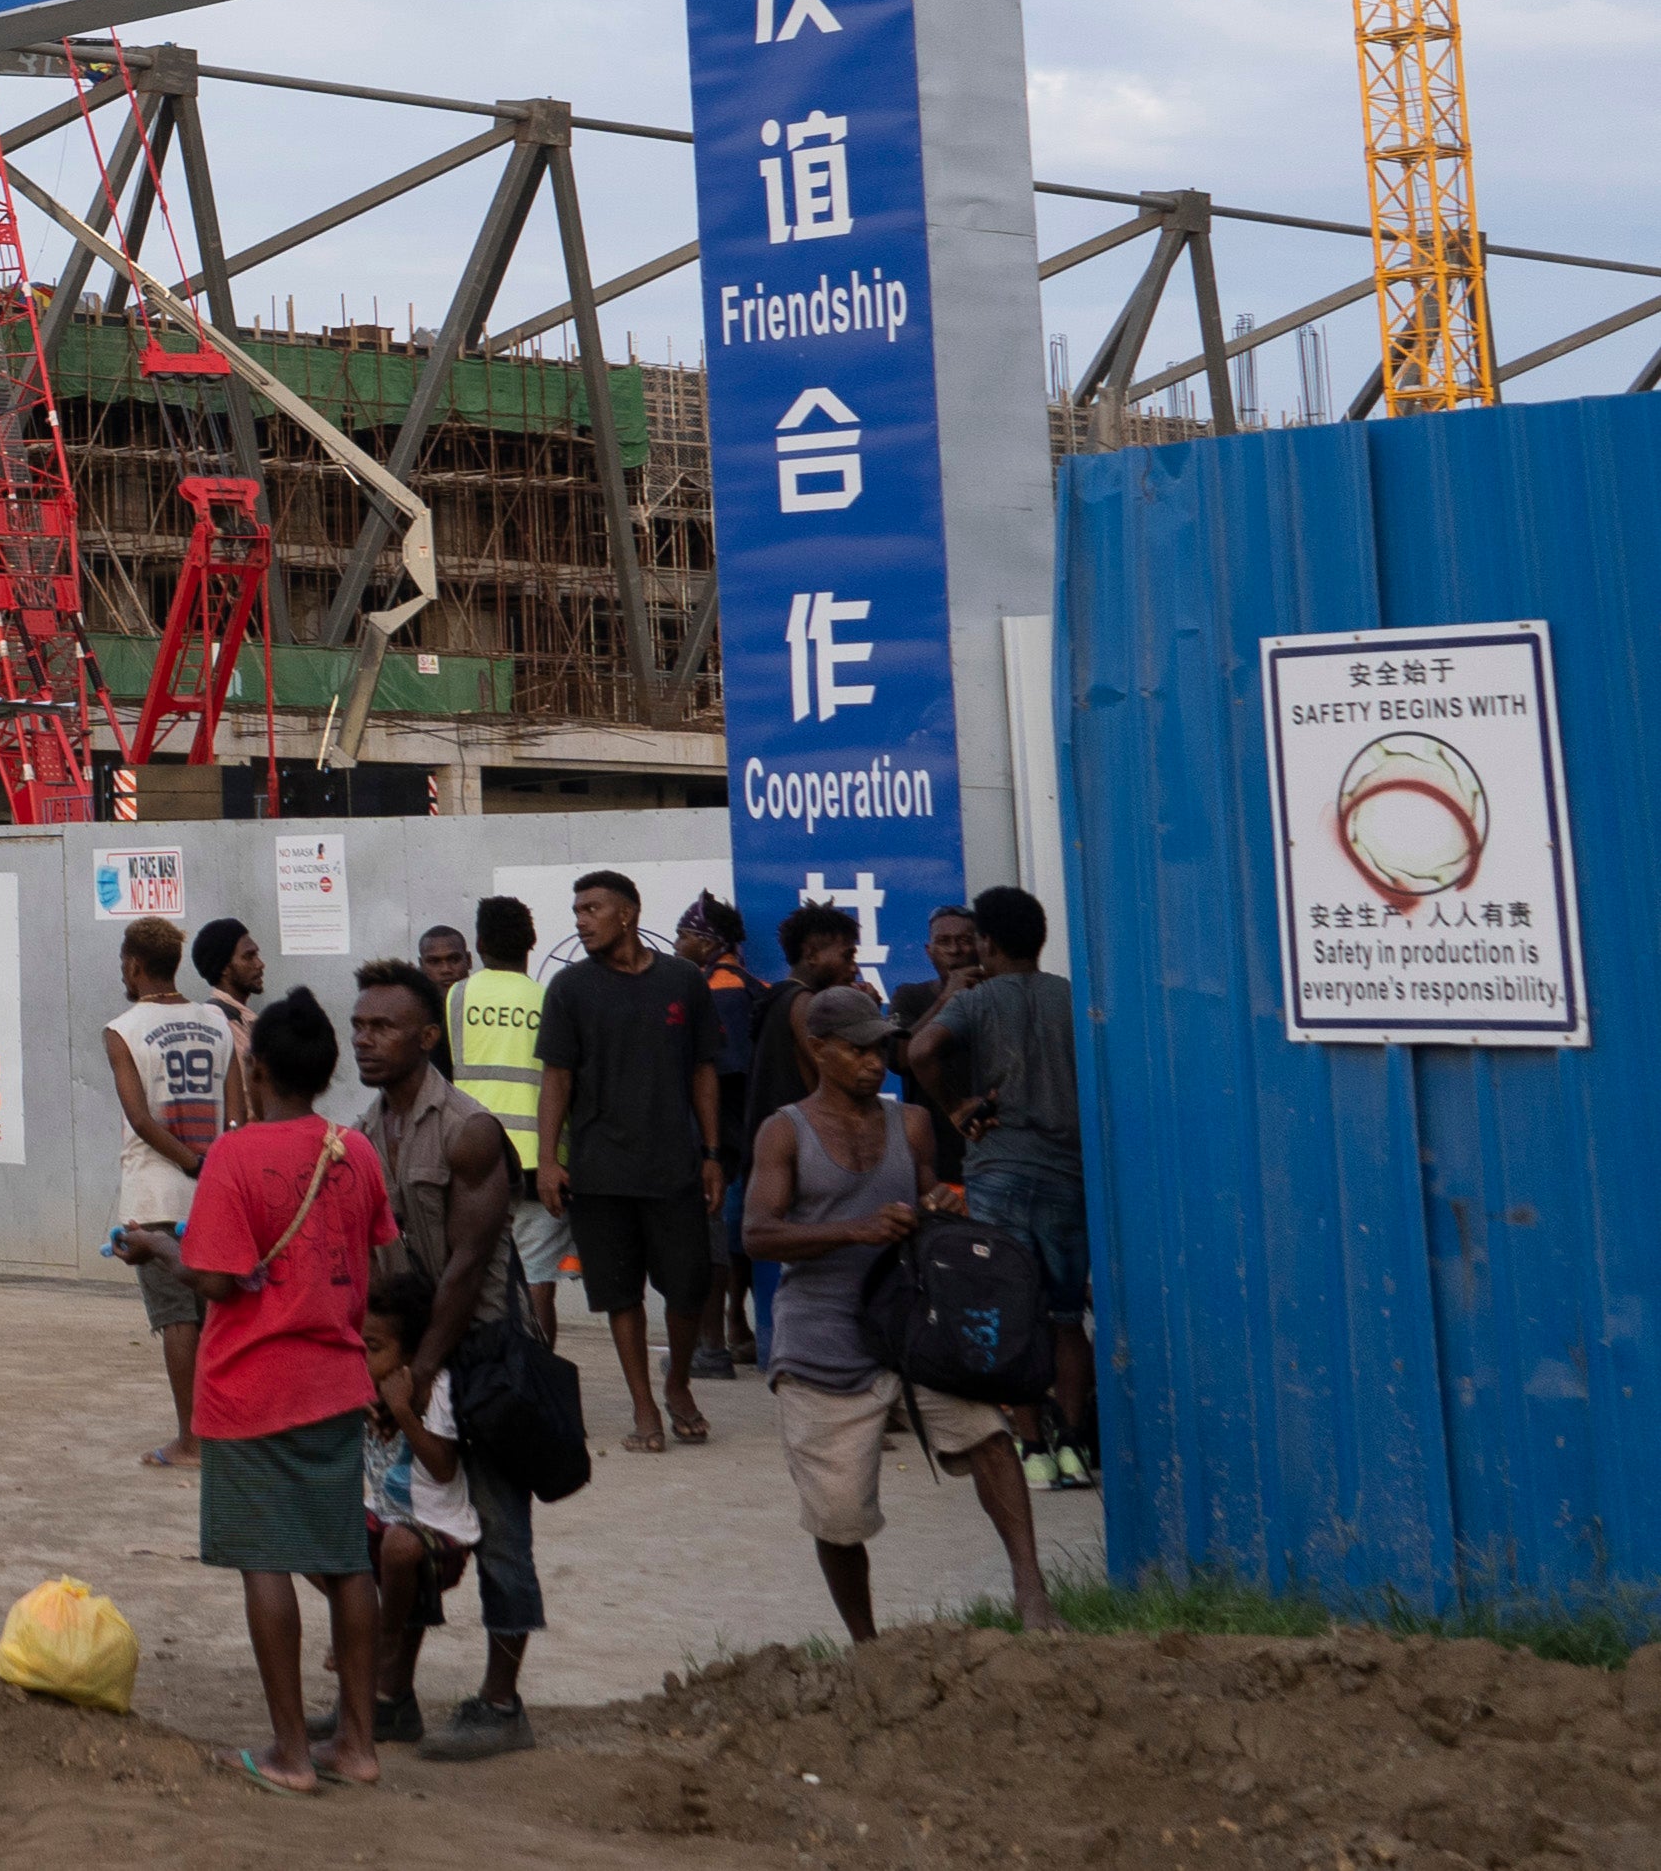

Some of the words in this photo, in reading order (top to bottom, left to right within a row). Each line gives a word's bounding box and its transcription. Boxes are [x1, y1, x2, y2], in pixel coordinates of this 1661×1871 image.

[720, 267, 908, 346] Friendship
[1349, 657, 1455, 688] 安全始于
[1291, 701, 1372, 726] SAFETY
[1379, 696, 1464, 721] BEGINS
[1468, 693, 1528, 718] WITH
[744, 753, 934, 834] Cooperation
[128, 857, 138, 879] NO
[140, 856, 157, 879] FACE
[158, 855, 178, 878] MASK
[280, 848, 291, 858] NO
[292, 848, 314, 857] MASK
[279, 865, 292, 874] NO
[292, 864, 331, 874] VACCINES
[131, 878, 145, 910] NO
[148, 878, 179, 910] ENTRY
[279, 882, 292, 891] NO
[293, 882, 318, 891] ENTRY
[1313, 939, 1373, 971] Safety
[1377, 939, 1396, 964] in
[1401, 938, 1515, 969] production
[1520, 938, 1540, 964] is
[1303, 977, 1406, 1007] everyone's
[1410, 976, 1564, 1009] responsibility.
[466, 1005, 542, 1031] CCECC
[144, 1021, 224, 1047] DEUTSCHER
[157, 1032, 216, 1049] MEISTER
